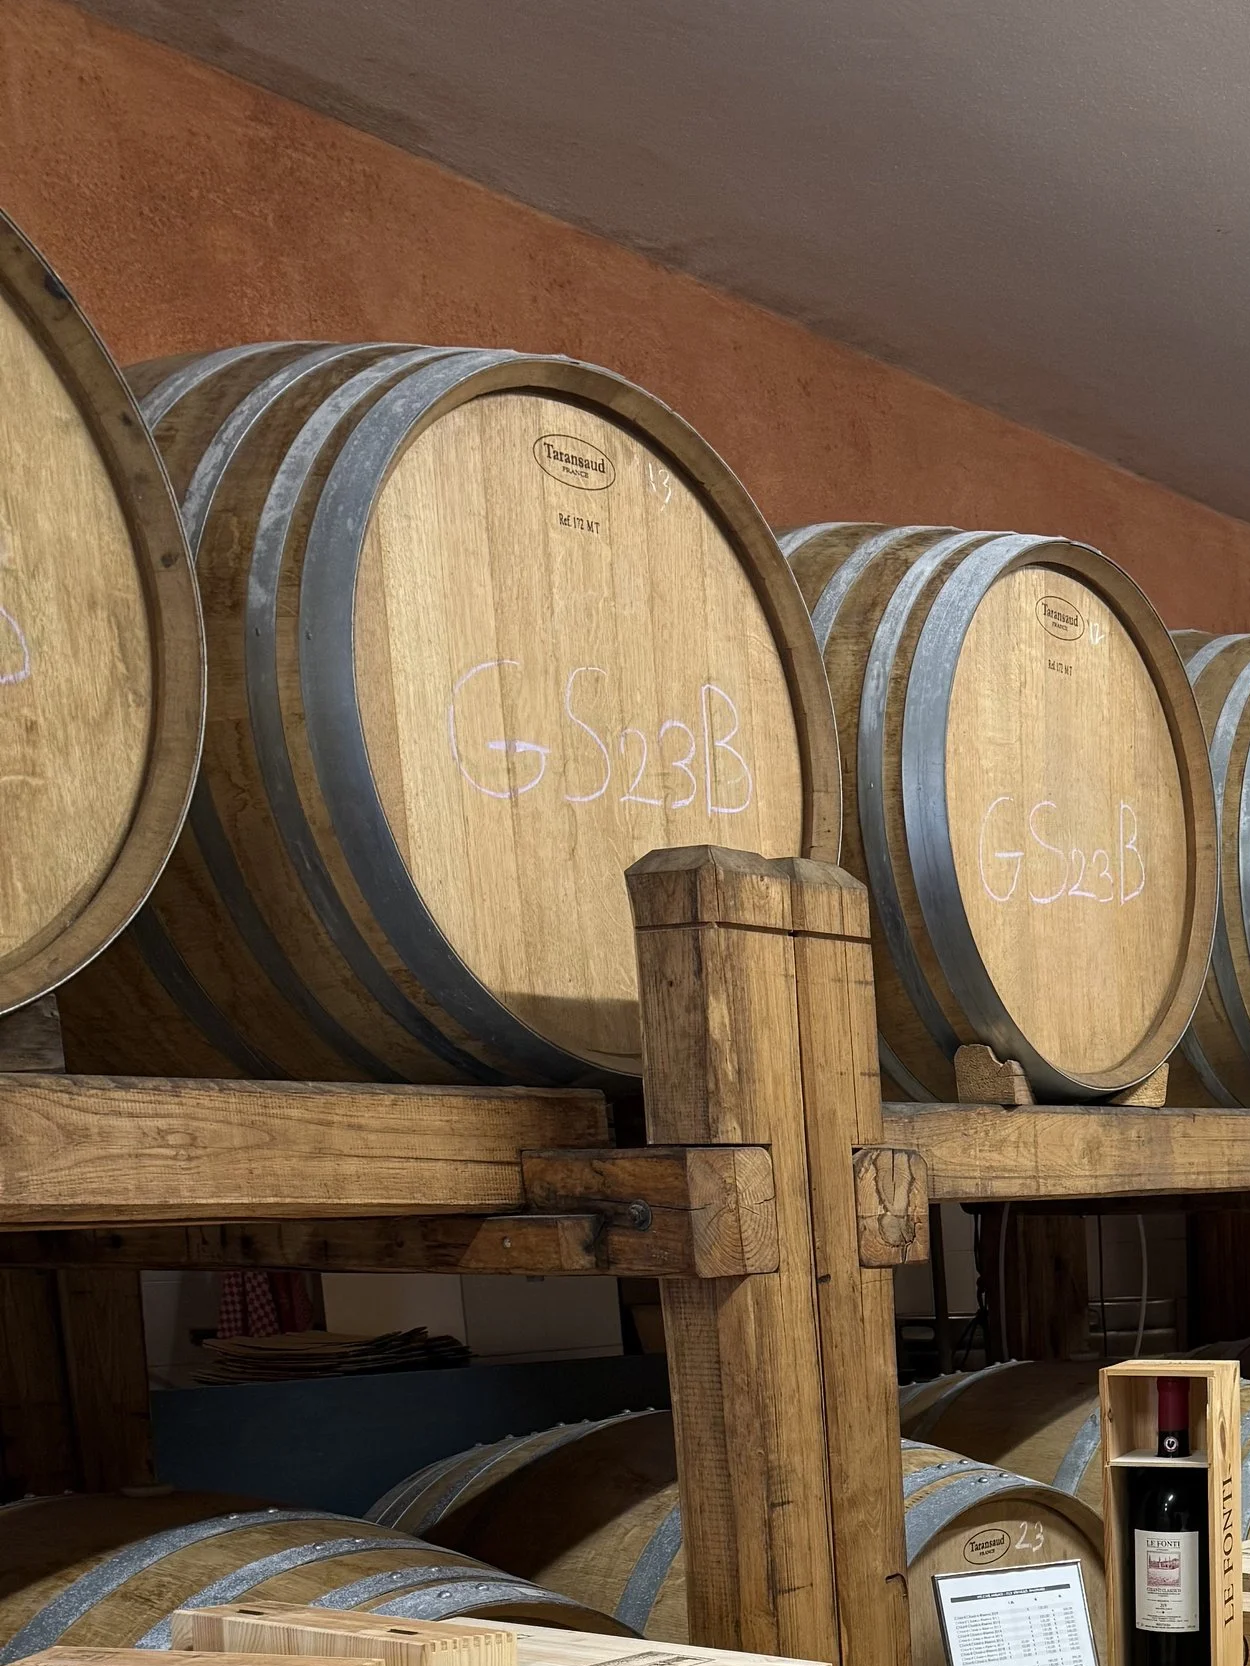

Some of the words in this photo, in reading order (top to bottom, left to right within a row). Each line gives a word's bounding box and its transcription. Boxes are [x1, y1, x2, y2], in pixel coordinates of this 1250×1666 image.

[544, 442, 606, 474] Taransaud
[562, 466, 589, 479] FRANCE
[1041, 602, 1079, 627] Taransaud
[448, 659, 753, 817] GS23B
[978, 796, 1146, 906] GS23B
[1014, 1520, 1045, 1553] 23
[1222, 1477, 1234, 1577] FONTI
[969, 1534, 1006, 1553] Taransaud
[1157, 1540, 1180, 1548] FONTI
[1224, 1583, 1234, 1628] LE
